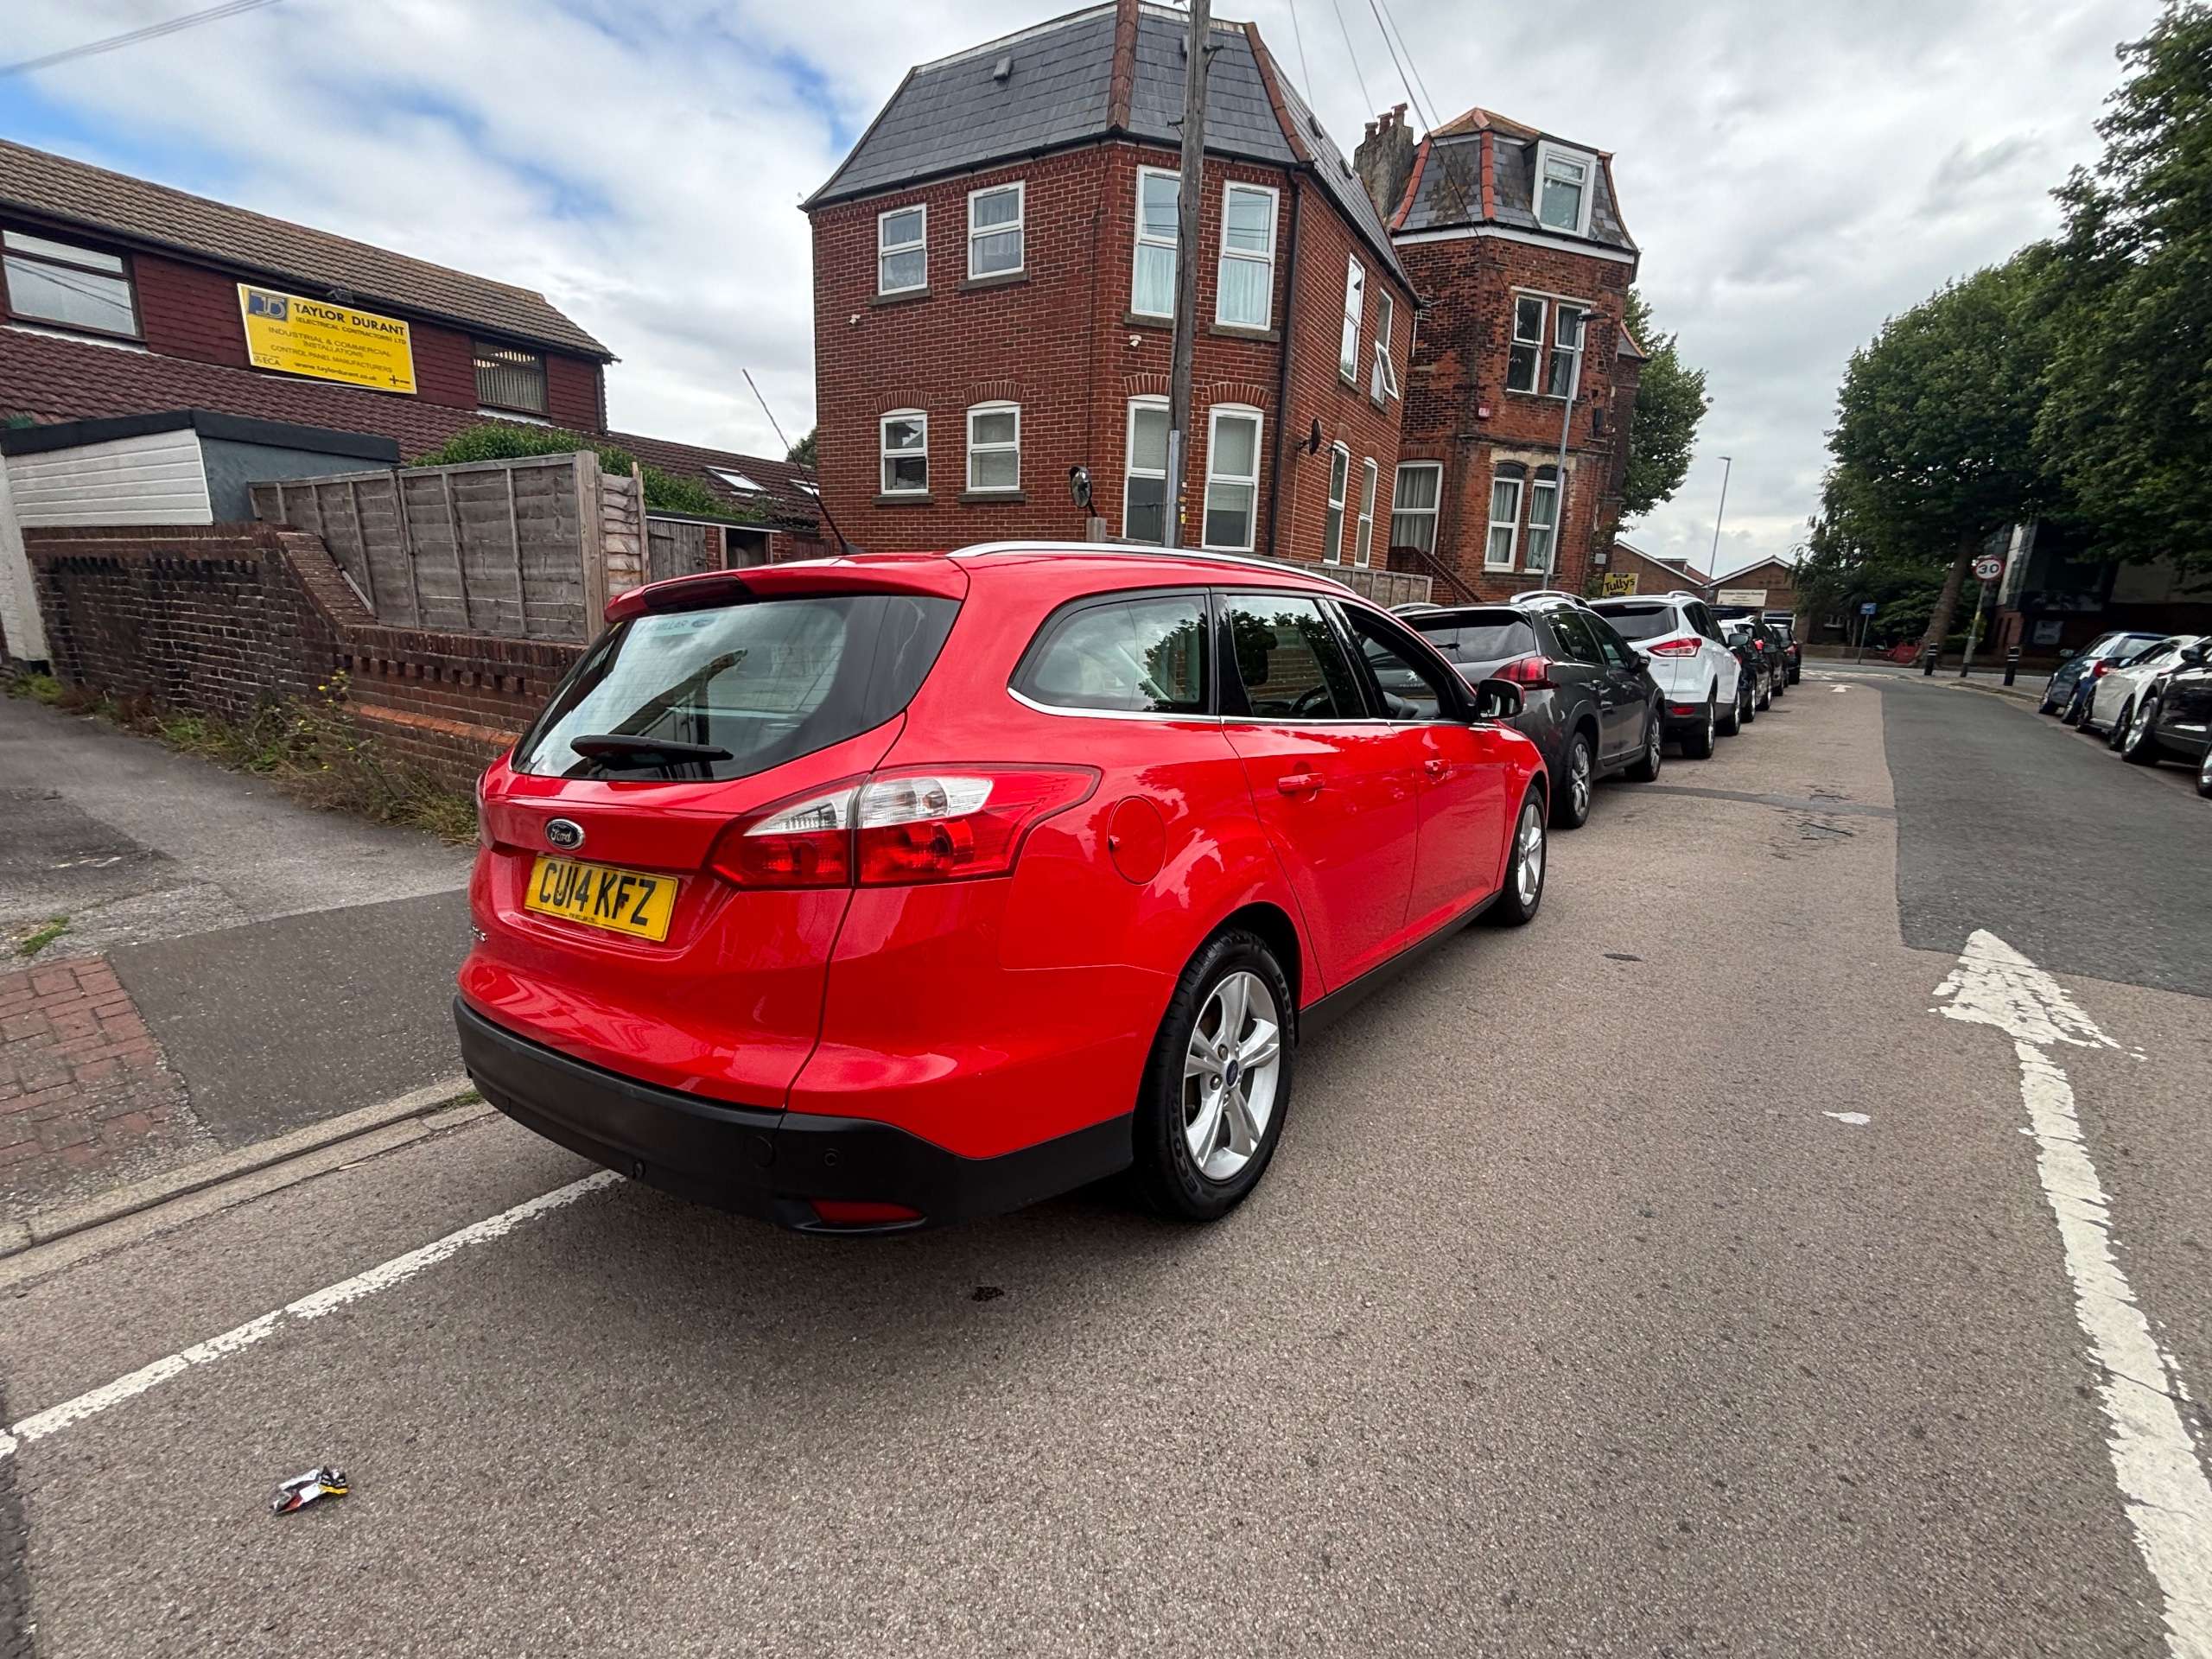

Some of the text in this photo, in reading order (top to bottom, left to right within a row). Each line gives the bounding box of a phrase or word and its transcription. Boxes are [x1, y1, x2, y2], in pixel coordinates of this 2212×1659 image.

[294, 302, 404, 335] TAYLOR DURANT
[269, 327, 324, 343] INDUSTRIAL
[334, 340, 391, 357] COMMERCIAL
[302, 340, 364, 358] INSTALLATIONS
[263, 356, 282, 366] ECA
[270, 344, 306, 357] CONTROL
[308, 352, 330, 361] PANEL
[333, 357, 392, 373] MANUFACTURERS
[294, 362, 378, 381] www.taylordurant.co.uk
[1978, 563, 1999, 575] 30
[550, 824, 572, 842] Ford
[539, 862, 657, 927] CU14 KFZ
